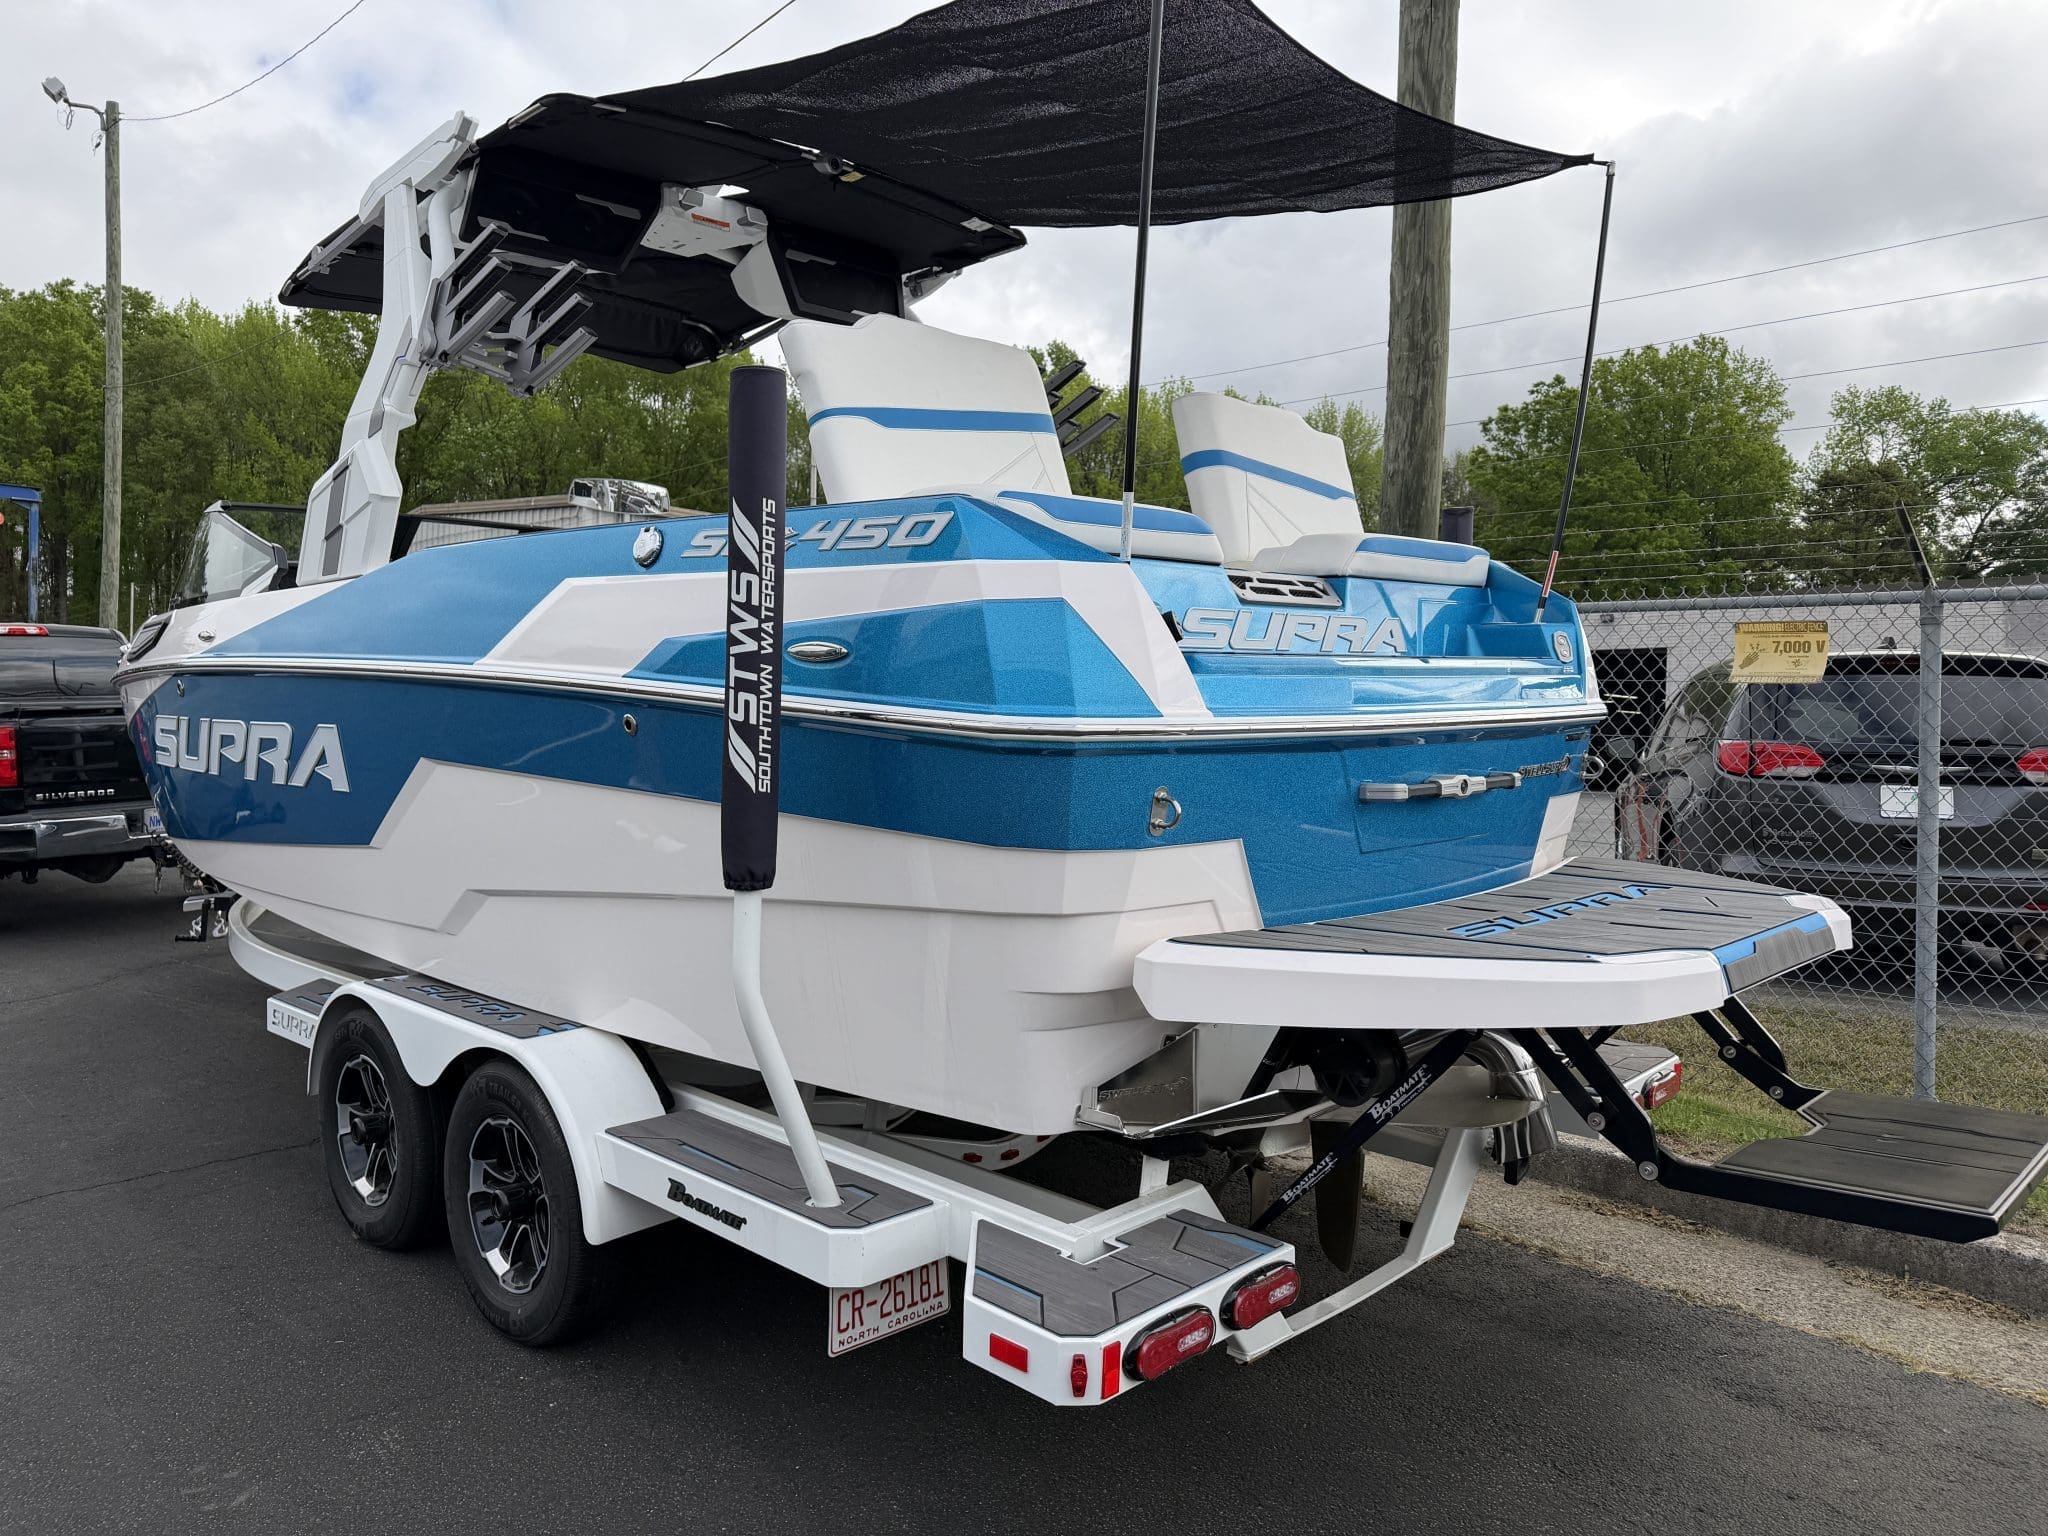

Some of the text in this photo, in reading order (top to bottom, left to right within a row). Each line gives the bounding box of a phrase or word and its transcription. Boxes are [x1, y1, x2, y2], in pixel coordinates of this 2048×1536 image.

[799, 511, 955, 551] 450
[728, 569, 760, 724] STWS
[758, 497, 776, 794] SOUTHTOWN WATERSPORTS
[1178, 607, 1408, 653] SUPRA
[1772, 640, 1826, 656] 7,000 V
[155, 714, 350, 793] SUPRA
[35, 788, 115, 801] SILVERADO
[1446, 884, 1674, 938] SUPRA
[406, 985, 528, 1022] SUPRA
[1366, 1066, 1427, 1120] BOATMATE
[667, 1177, 743, 1231] BOATMATE
[1280, 1153, 1333, 1203] BOATMATE
[837, 1259, 944, 1334] CR-26181
